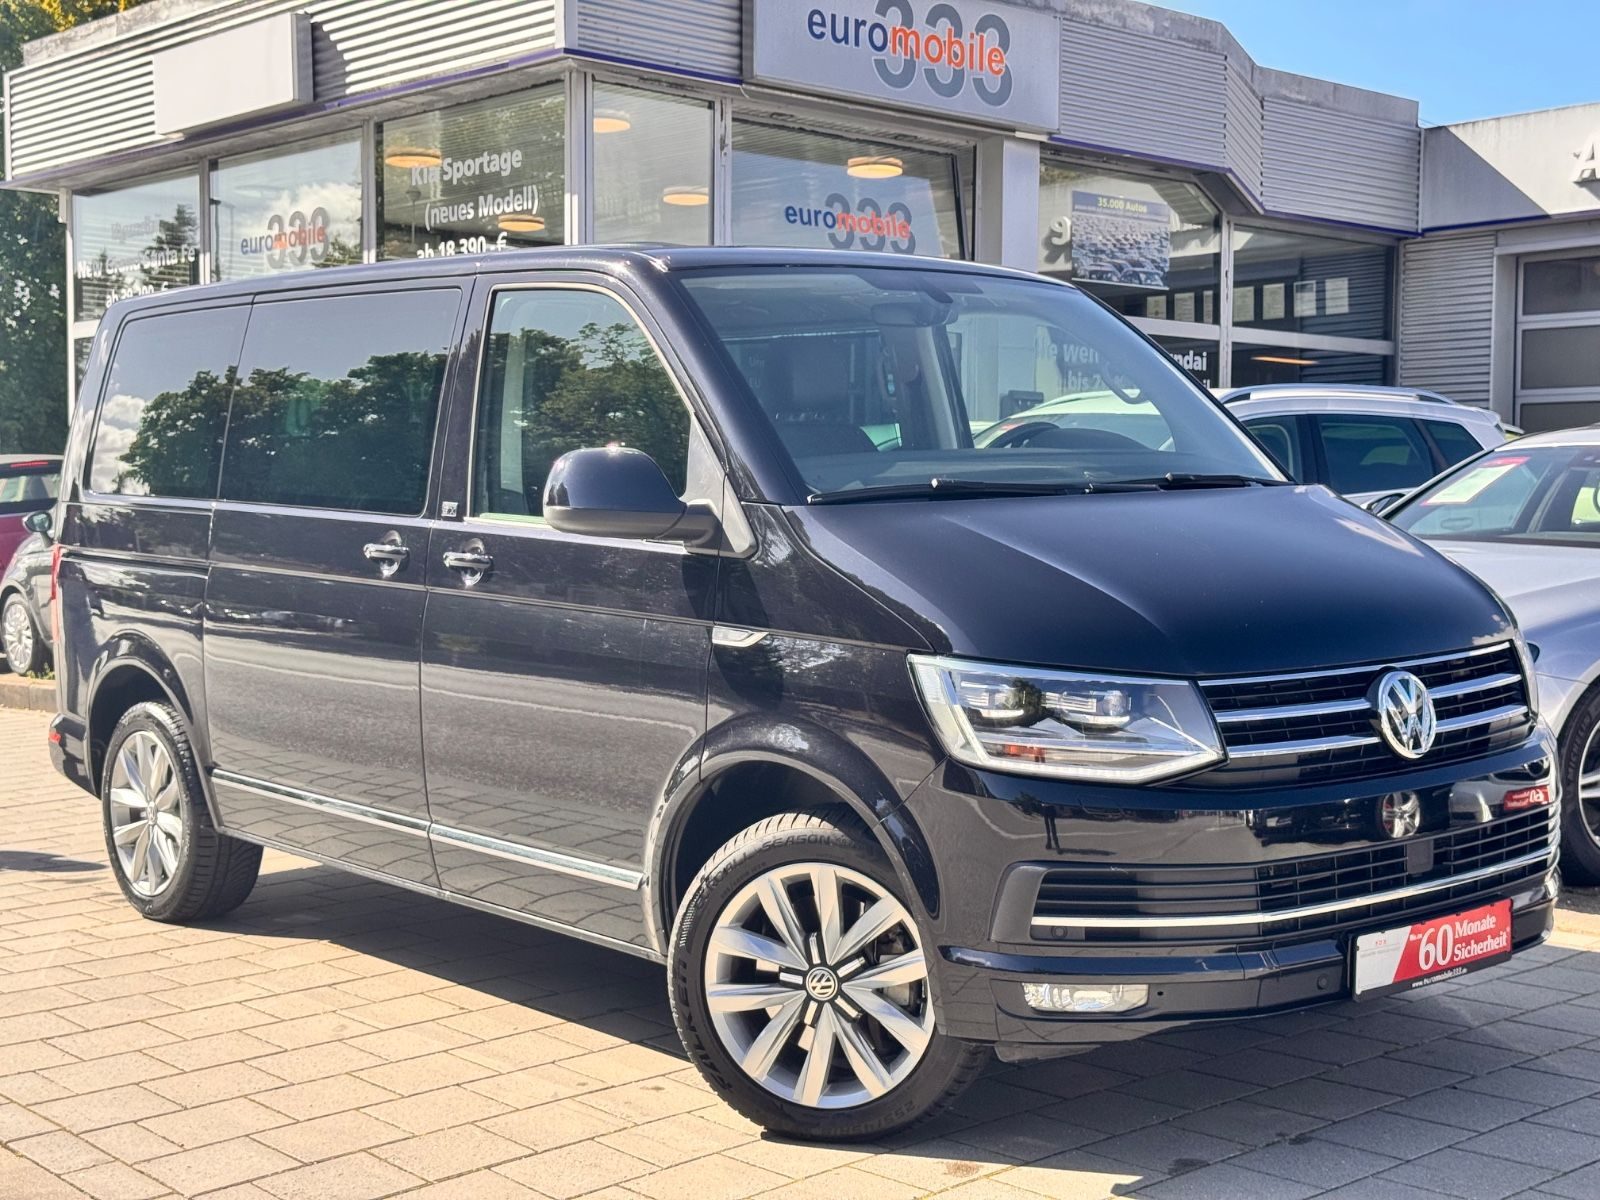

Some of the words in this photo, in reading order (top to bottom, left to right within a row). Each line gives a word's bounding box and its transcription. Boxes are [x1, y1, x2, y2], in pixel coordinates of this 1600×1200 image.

[442, 149, 523, 185] Sportage
[424, 202, 475, 231] (neues
[478, 184, 539, 217] Modell)
[1097, 197, 1125, 210] 35.000
[1125, 201, 1148, 214] Autos
[181, 243, 196, 263] Fe
[1418, 924, 1454, 971] 60
[1454, 914, 1497, 939] Monate
[1453, 930, 1508, 962] Sicherheit
